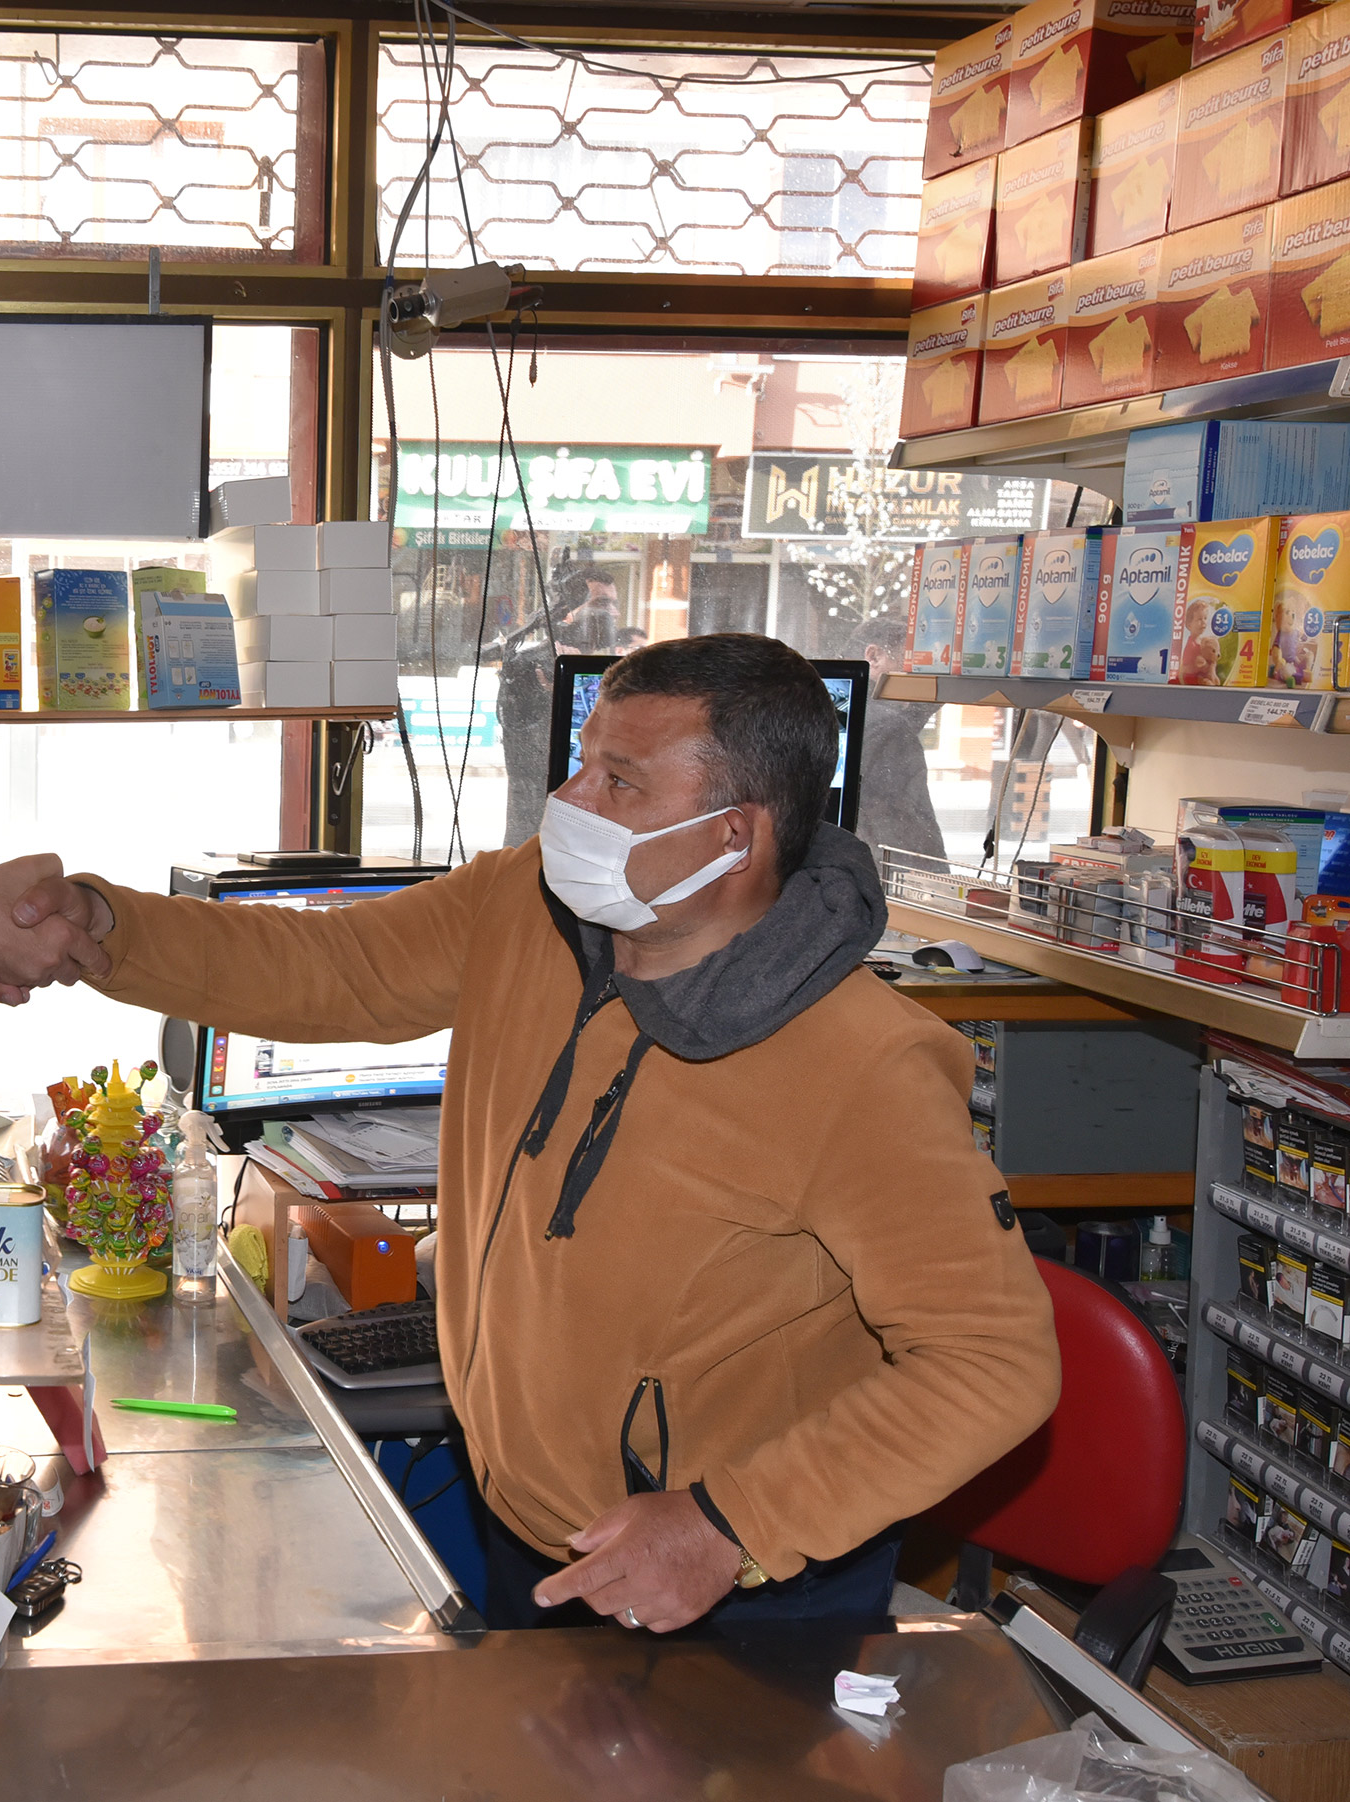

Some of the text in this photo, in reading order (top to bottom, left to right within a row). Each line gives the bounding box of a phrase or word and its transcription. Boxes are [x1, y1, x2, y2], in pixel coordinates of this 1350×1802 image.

[1150, 1, 1197, 17] beurr
[1019, 9, 1081, 57] petit beurre
[1262, 48, 1284, 67] Bifa
[1299, 41, 1339, 79] petit
[938, 53, 1001, 95] petit beurre
[1185, 77, 1271, 129] petit beurre
[1003, 161, 1064, 198] petit beurre
[1243, 219, 1264, 239] Bifa
[1282, 213, 1350, 256] petit beu
[1168, 248, 1253, 287] petit beurre
[1076, 279, 1145, 312] petit beurre
[992, 305, 1054, 337] petit beurre
[913, 329, 968, 357] petit beurre
[402, 447, 705, 508] KULU ŞİFA EVİ
[1149, 486, 1170, 498] Aptamil
[901, 499, 960, 515] EMLAK
[1201, 549, 1248, 564] bebelac
[1292, 545, 1334, 560] bebelac
[923, 574, 956, 591] Aptamil
[972, 572, 1010, 591] Aptamil
[1035, 566, 1077, 585] Aptamil
[1119, 566, 1171, 587] Aptamil
[908, 556, 921, 634] EKONOMİK
[956, 552, 969, 635] EKONOMİK
[1017, 546, 1033, 633] EKONOMİK
[1173, 545, 1191, 640] EKONOMİK
[1098, 590, 1108, 623] 900
[941, 645, 950, 666] 4
[995, 647, 1006, 669] 3
[1060, 645, 1073, 669] 2
[1159, 649, 1168, 674] 1
[1240, 640, 1254, 661] 4
[1176, 897, 1211, 915] Gillette
[1214, 1641, 1284, 1657] HUGIN
